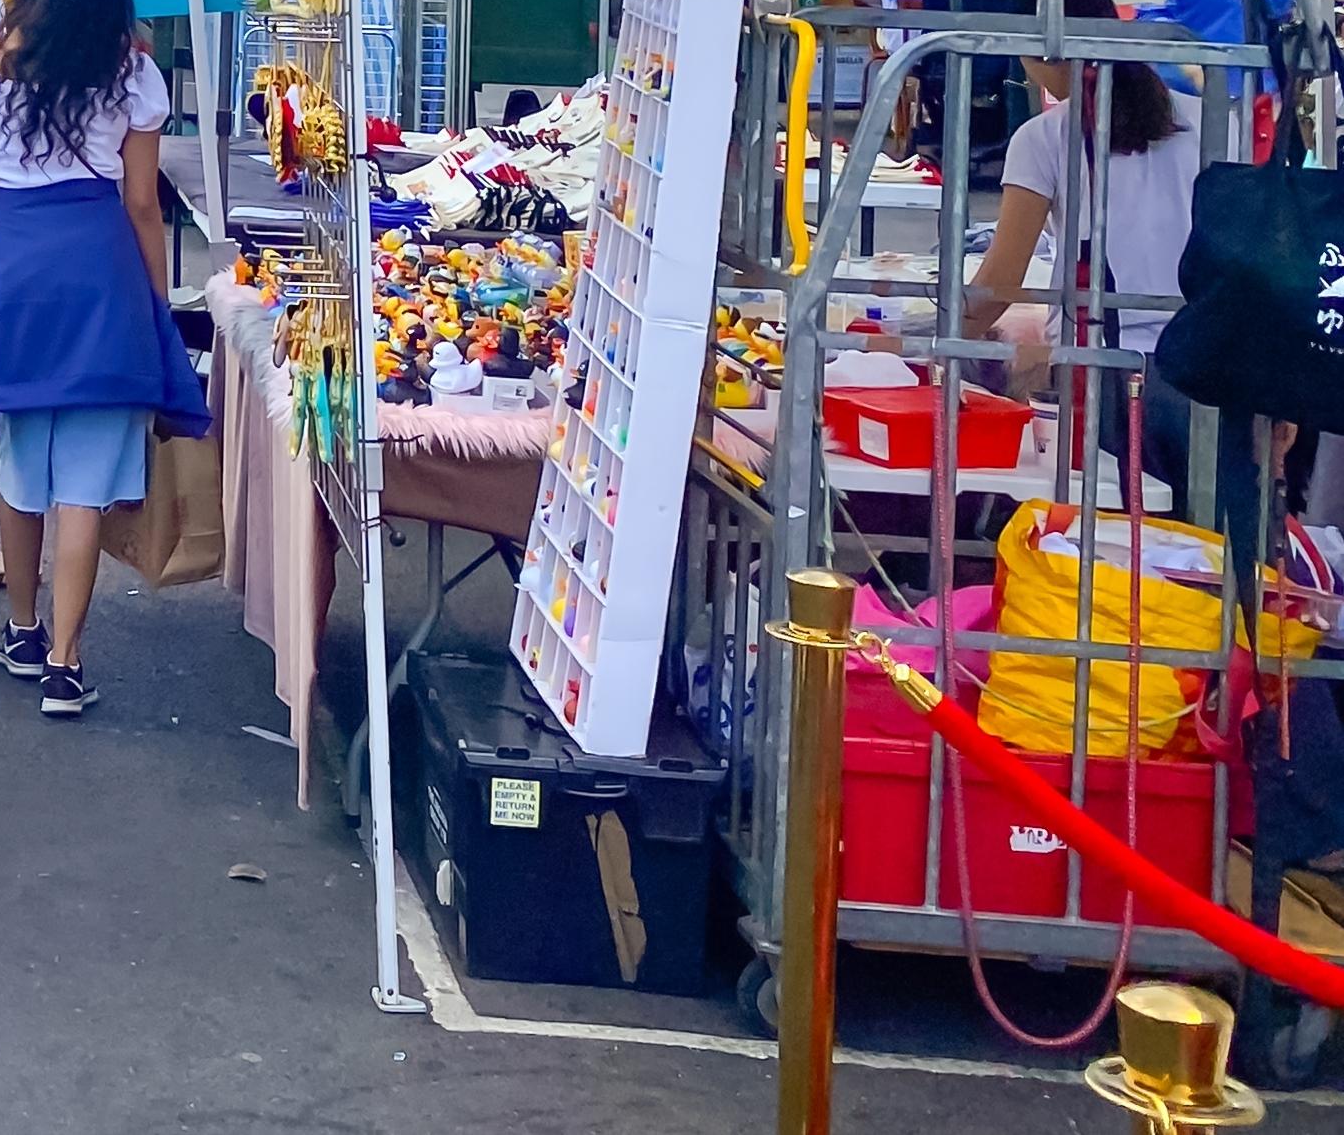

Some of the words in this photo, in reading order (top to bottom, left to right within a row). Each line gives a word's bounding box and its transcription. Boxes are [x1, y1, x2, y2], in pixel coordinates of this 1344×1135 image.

[497, 781, 535, 791] PLEASE
[494, 791, 527, 801] EMPTY
[495, 801, 535, 811] RETURN
[495, 811, 507, 819] ME
[512, 812, 535, 821] NOW
